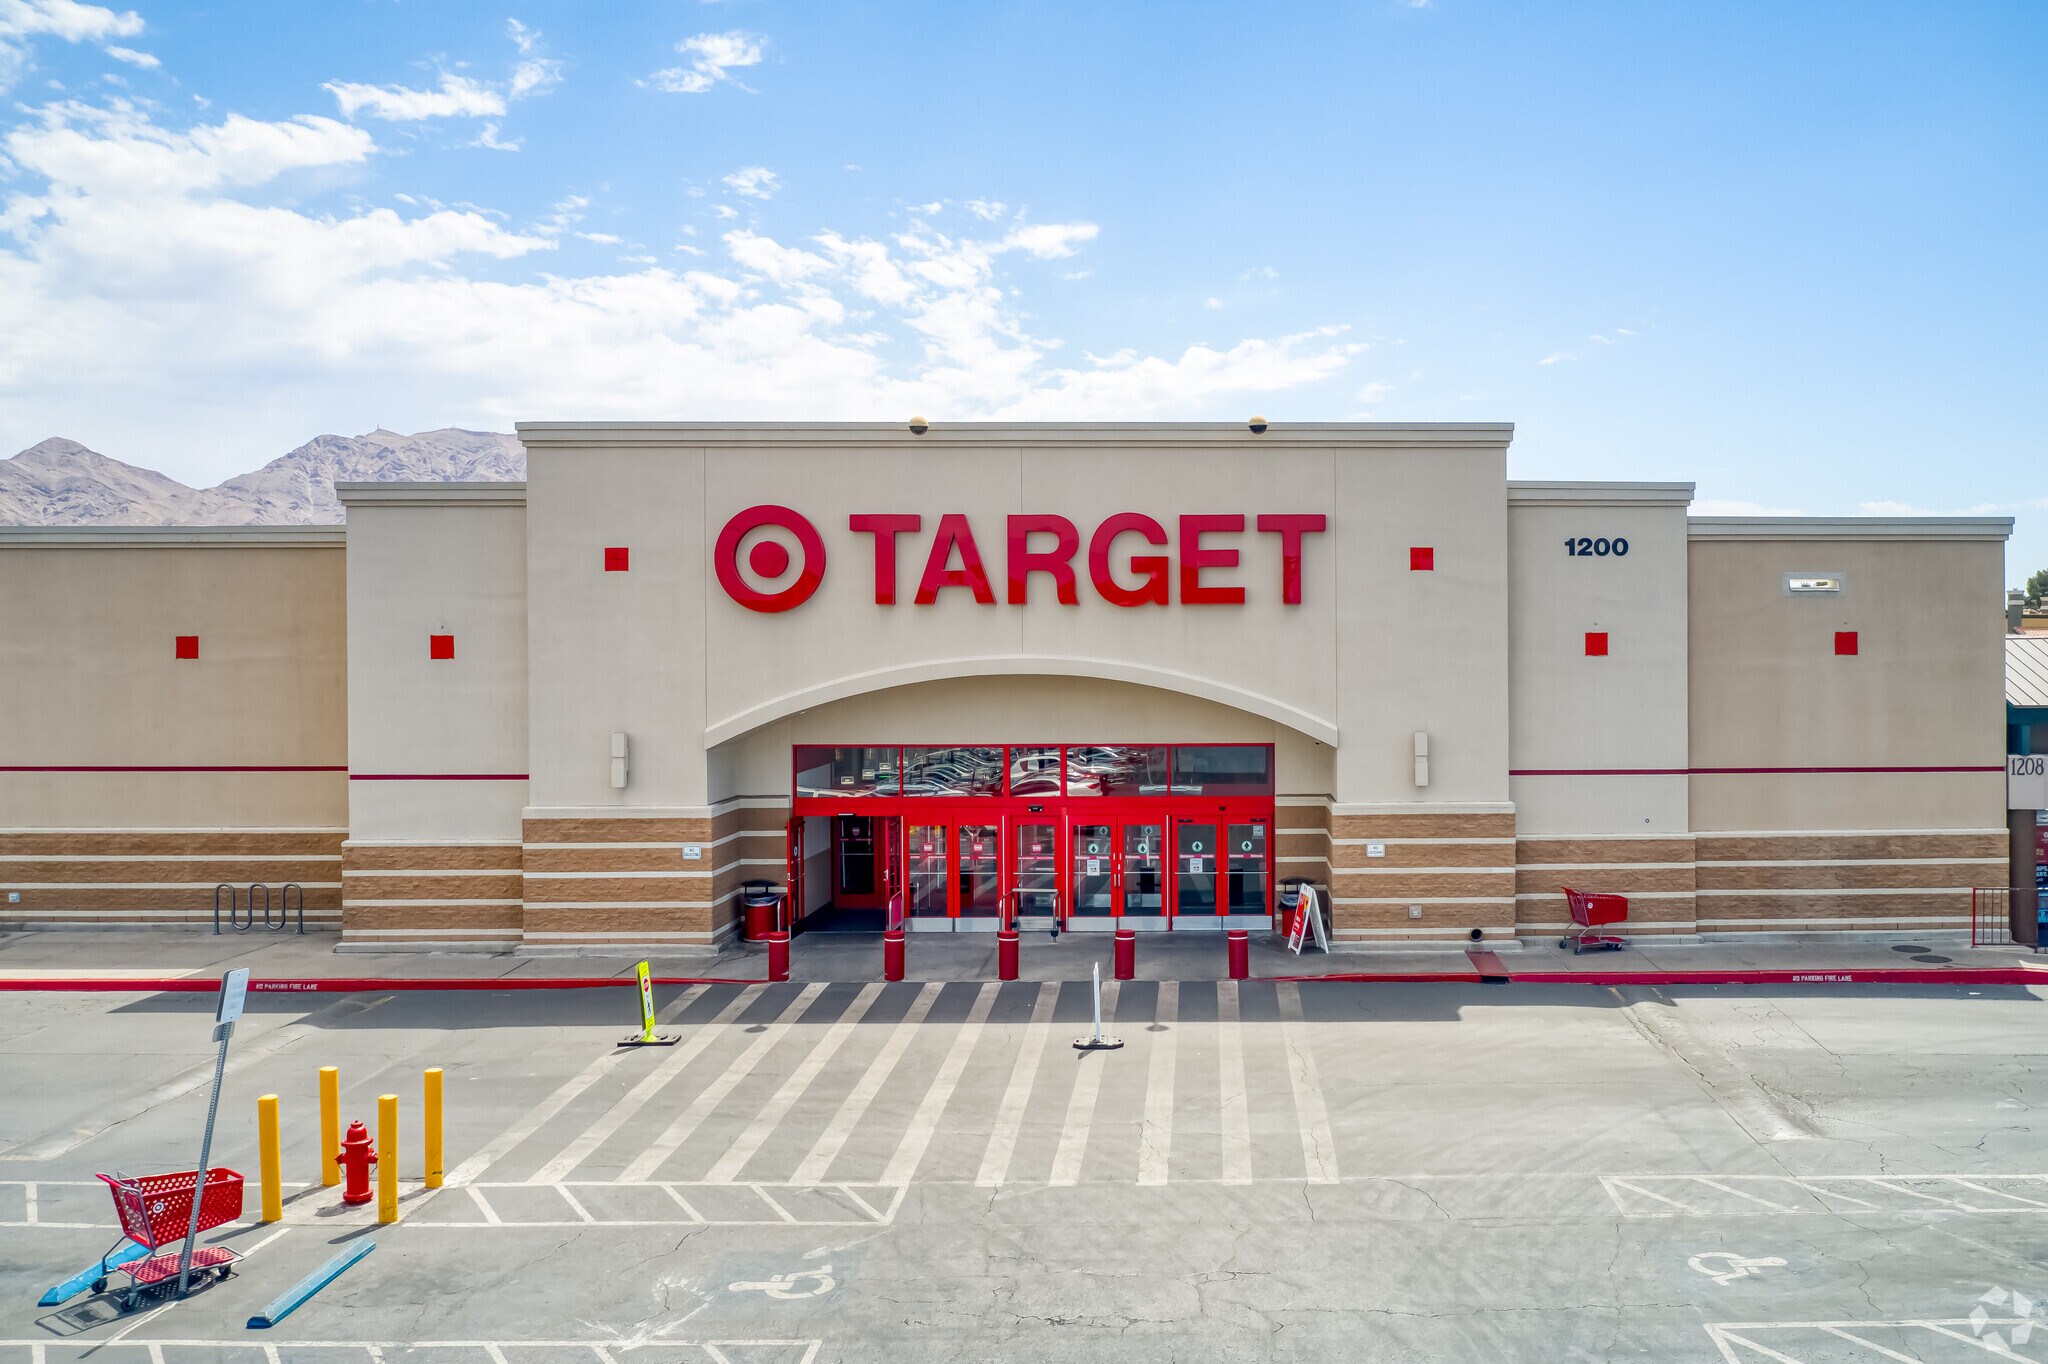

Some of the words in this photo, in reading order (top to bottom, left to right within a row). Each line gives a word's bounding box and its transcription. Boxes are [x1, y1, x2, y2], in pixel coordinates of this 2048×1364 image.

[1564, 537, 1629, 556] 1200
[848, 511, 1327, 607] TARGET
[2011, 757, 2044, 776] 1208
[303, 983, 318, 991] LANE
